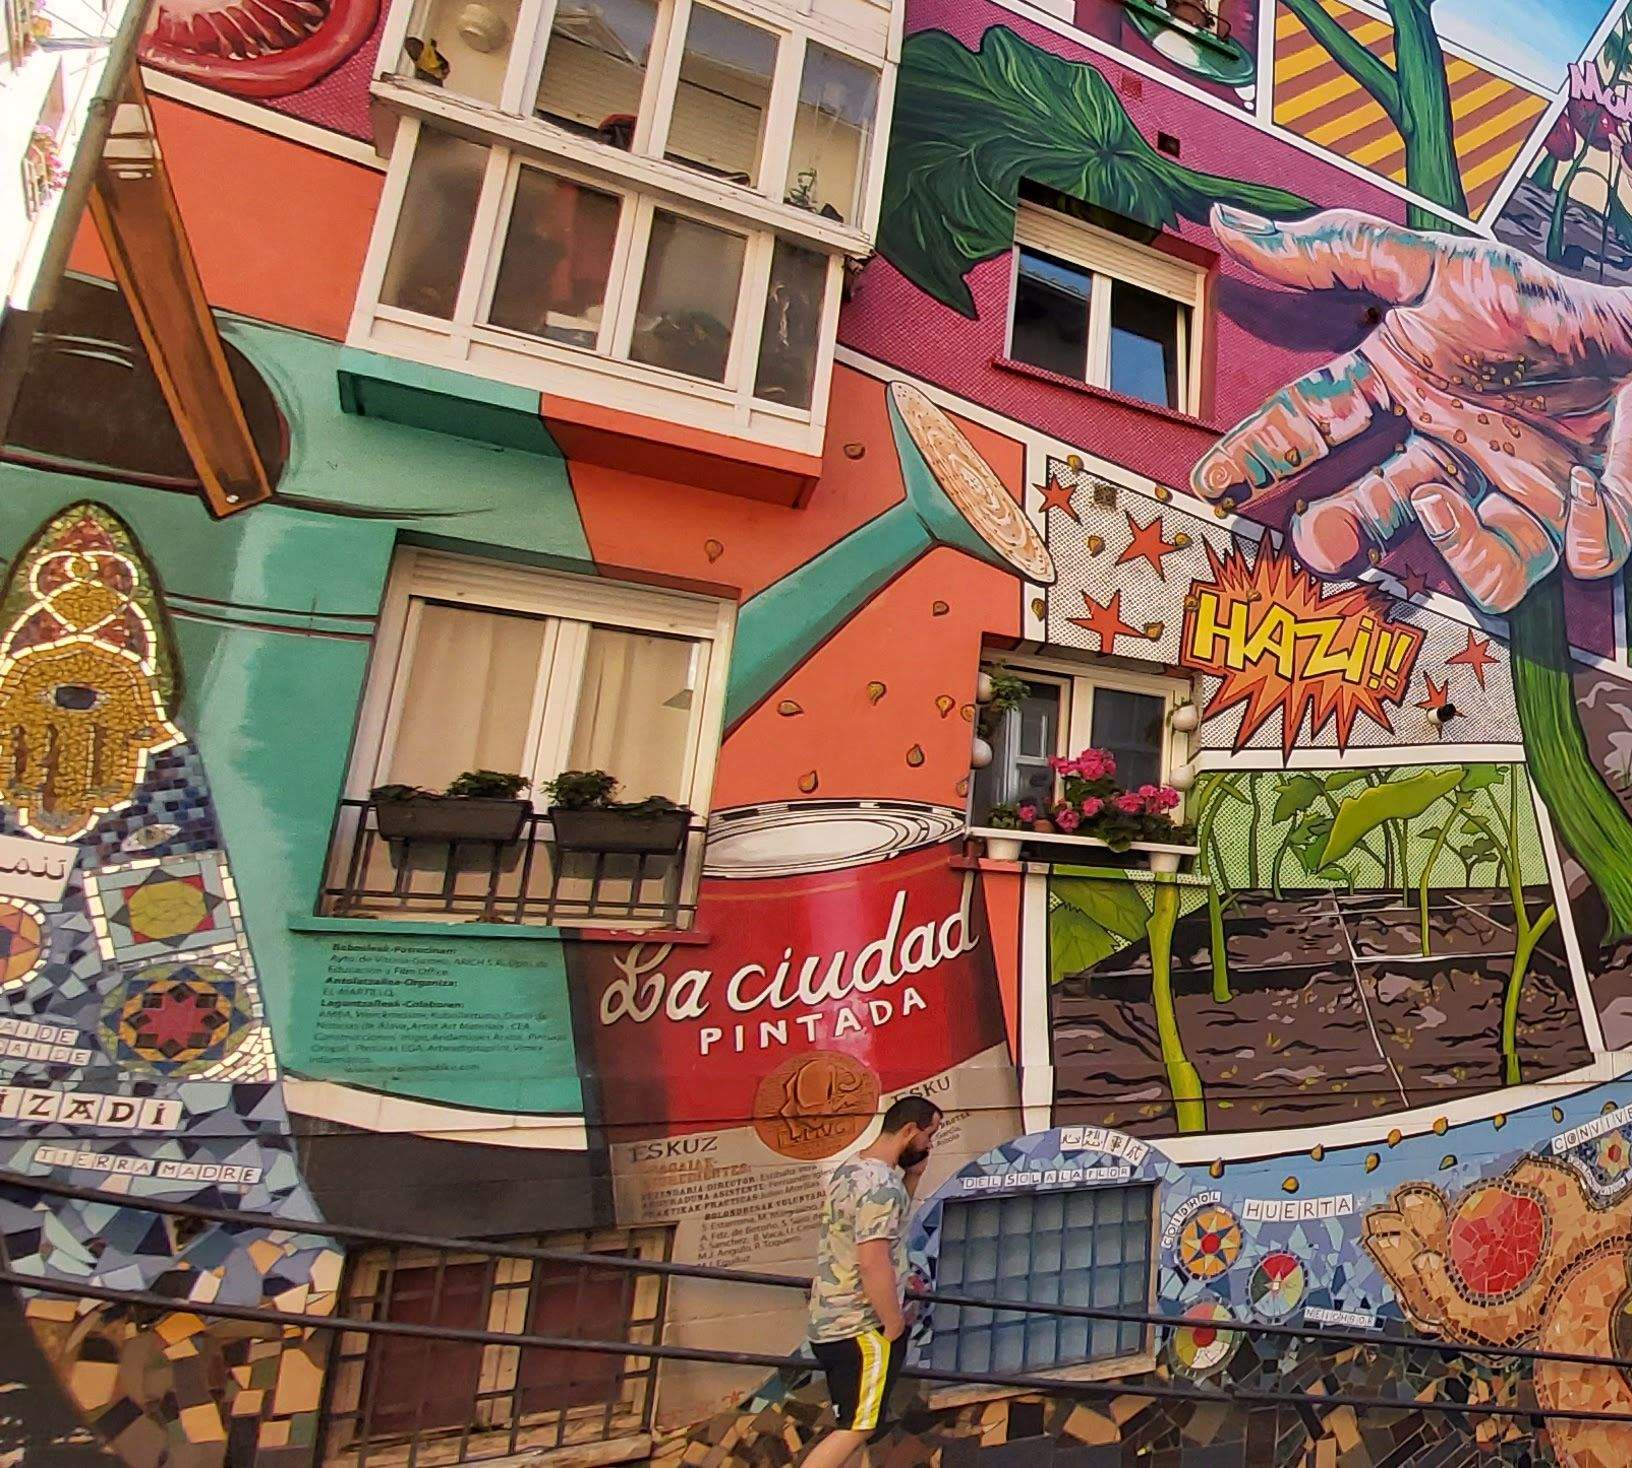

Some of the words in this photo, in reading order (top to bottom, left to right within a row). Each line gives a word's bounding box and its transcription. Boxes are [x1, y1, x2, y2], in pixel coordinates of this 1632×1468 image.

[600, 943, 712, 1025] La
[727, 870, 980, 1012] ciudad
[699, 986, 927, 1056] PINTADA
[629, 1135, 719, 1163] ESKUZ
[39, 1148, 150, 1173] TIERRA
[162, 1163, 260, 1182] MADRE
[965, 1177, 999, 1189] DEL
[1006, 1174, 1041, 1186] SOL
[1087, 1167, 1130, 1181] FLOR
[1246, 1198, 1352, 1220] HUERTA
